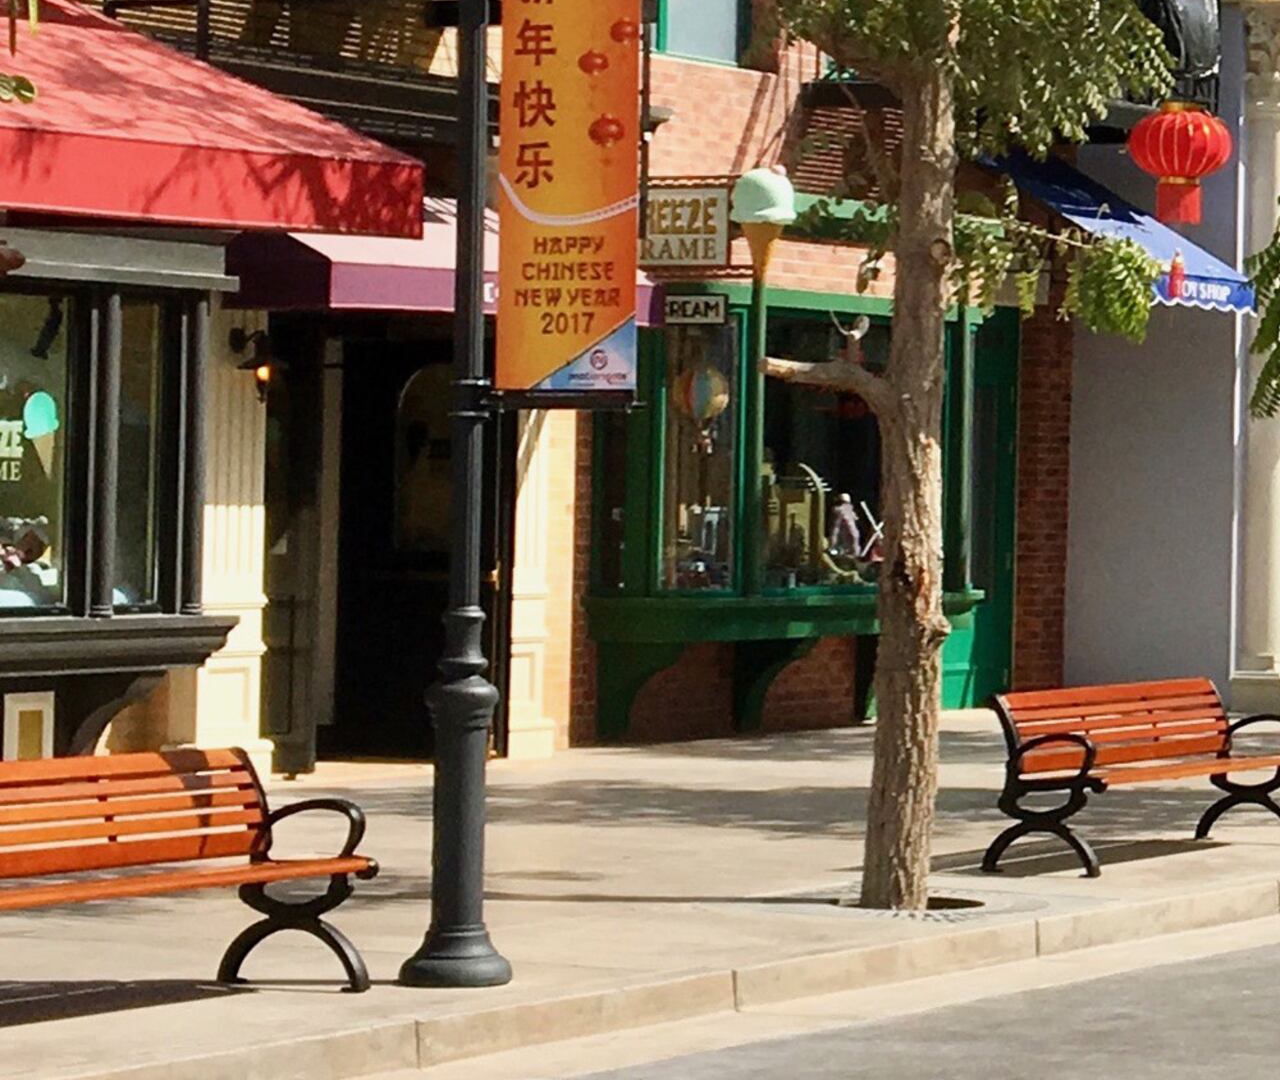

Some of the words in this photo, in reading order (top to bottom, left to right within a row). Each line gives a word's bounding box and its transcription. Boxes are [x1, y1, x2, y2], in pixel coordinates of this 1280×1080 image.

[533, 236, 604, 255] HAPPY
[640, 238, 717, 260] RAME
[521, 261, 614, 281] CHINESE
[514, 287, 562, 307] NEW
[566, 287, 621, 307] YEAR
[1199, 282, 1231, 302] SHOP
[540, 312, 595, 335] 2017
